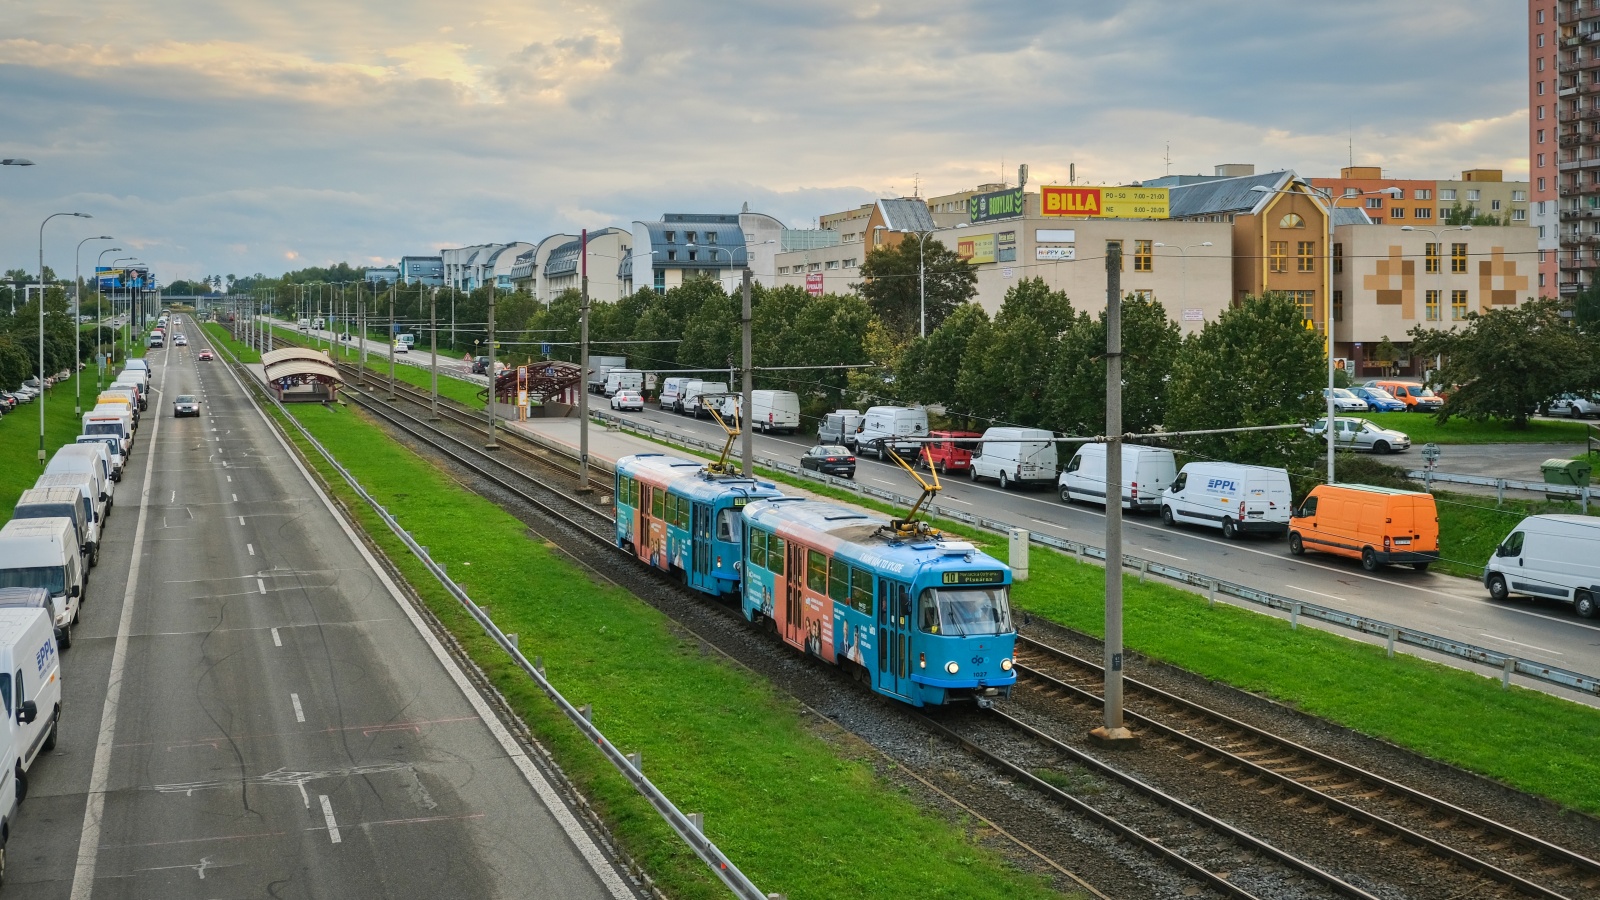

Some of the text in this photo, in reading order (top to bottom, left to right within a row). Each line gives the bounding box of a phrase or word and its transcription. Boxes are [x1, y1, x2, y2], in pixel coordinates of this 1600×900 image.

[1047, 193, 1097, 211] BILLA
[958, 244, 973, 257] BILLA
[1214, 480, 1236, 491] PPL
[946, 573, 956, 582] 10
[40, 638, 54, 666] PPL
[971, 655, 990, 666] dpo
